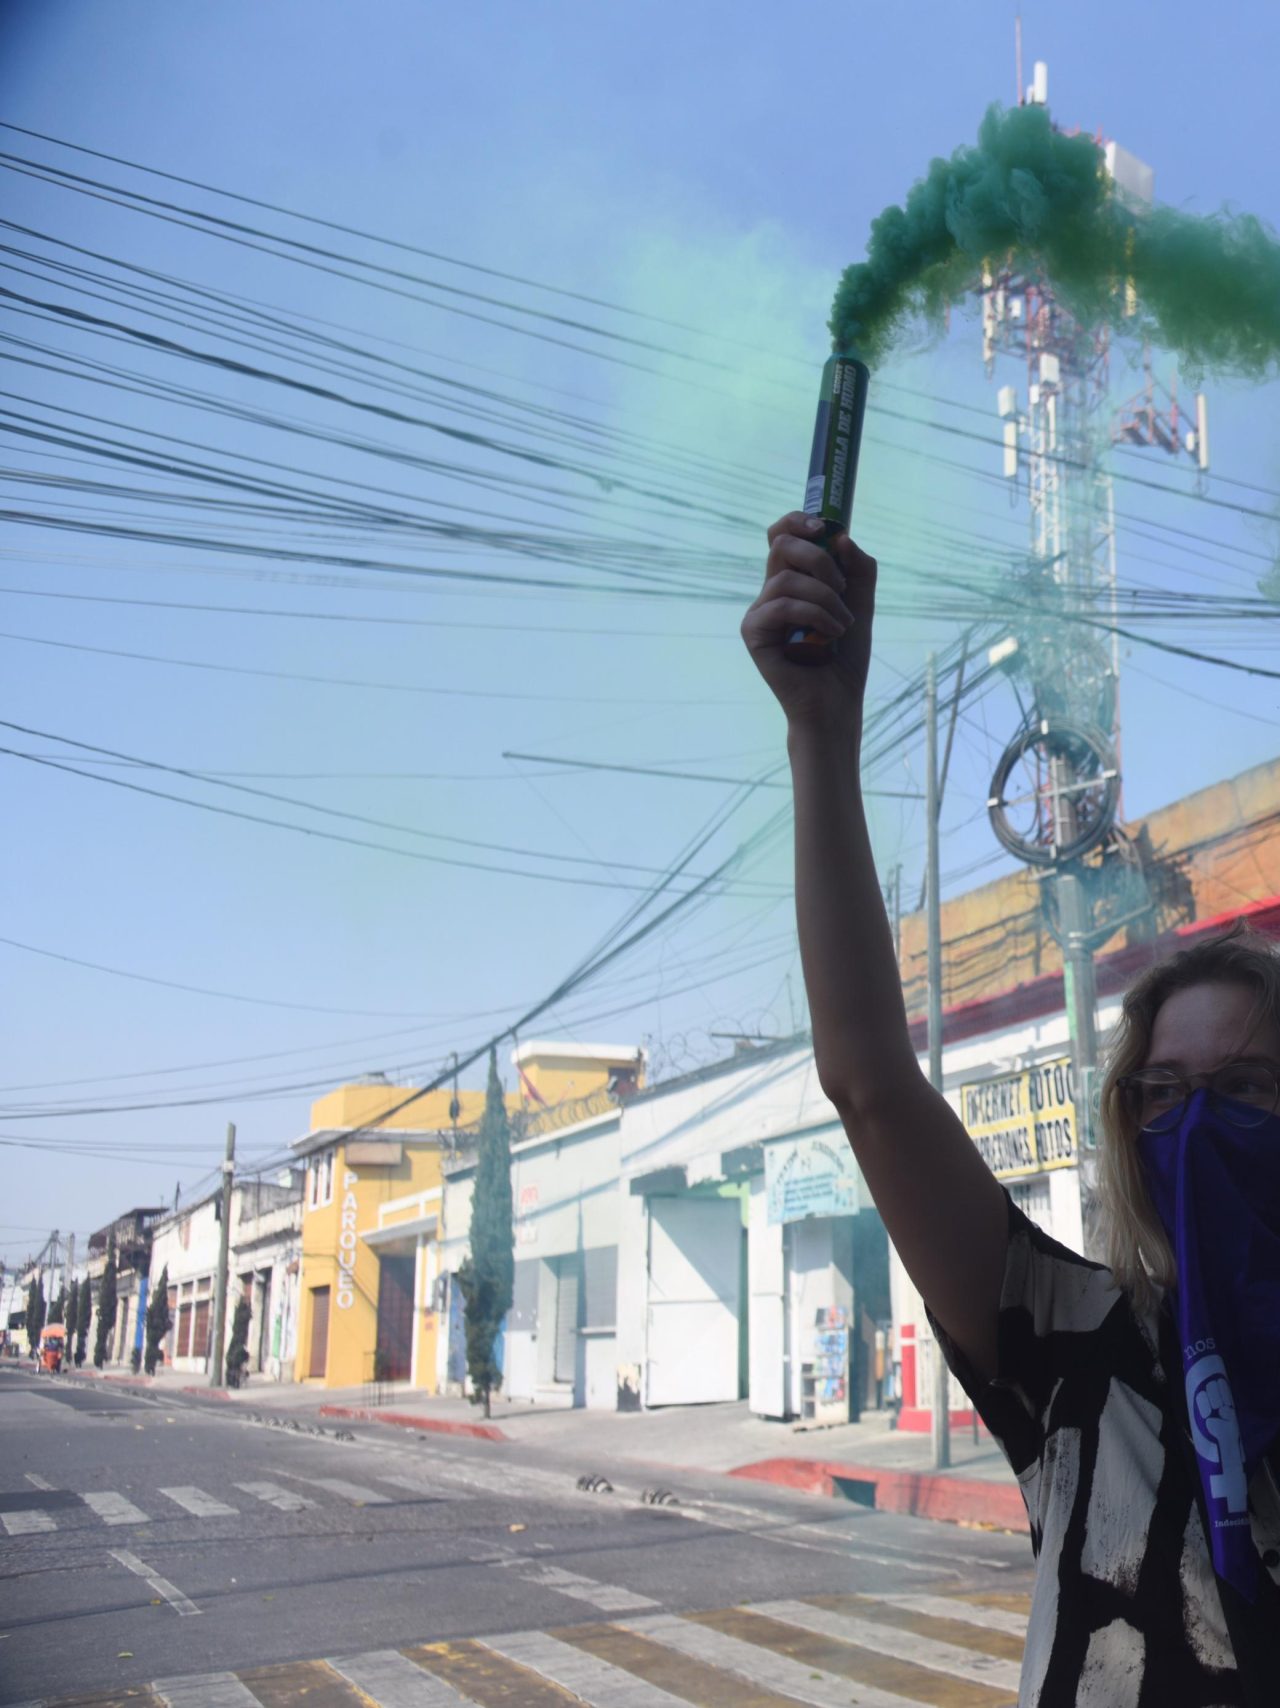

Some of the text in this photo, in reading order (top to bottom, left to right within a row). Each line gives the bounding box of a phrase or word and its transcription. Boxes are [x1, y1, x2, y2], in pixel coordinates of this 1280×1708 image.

[841, 364, 857, 409] HUMO
[837, 411, 852, 434] DE
[829, 435, 849, 509] BENGALA
[1034, 1117, 1072, 1162] FOTOS
[336, 1171, 357, 1310] PARQUEO
[1184, 1337, 1216, 1360] nos
